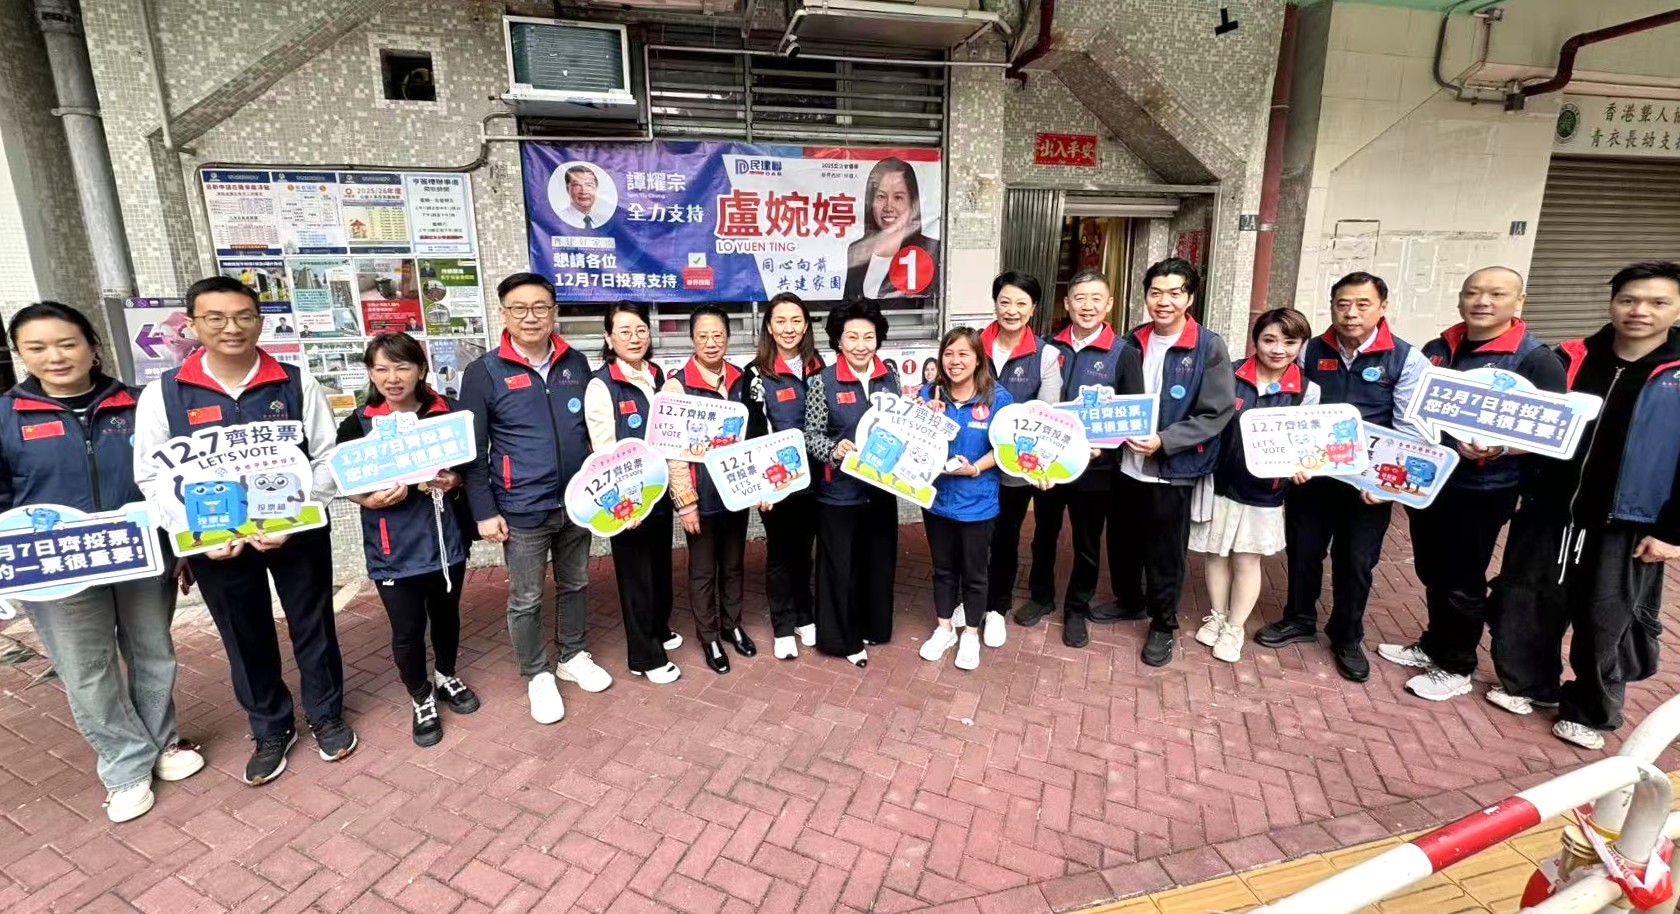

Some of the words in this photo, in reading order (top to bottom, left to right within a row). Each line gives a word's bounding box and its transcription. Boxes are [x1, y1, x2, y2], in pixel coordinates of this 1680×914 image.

[1039, 138, 1094, 160] 出入平安
[750, 160, 782, 172] 民建聯
[626, 172, 686, 192] 譚耀宗
[357, 187, 402, 195] 2025/26年度
[627, 202, 705, 223] 全力支持
[717, 189, 857, 239] 盧婉婷
[1244, 215, 1256, 230] 2A
[718, 241, 732, 252] LO
[736, 241, 765, 252] YUEN
[769, 242, 796, 252] TING
[553, 252, 617, 269] 懇請各位
[762, 257, 828, 272] 同心向前
[899, 249, 918, 290] 1
[555, 272, 678, 289] 12月7日投票支持
[777, 276, 842, 291] 共建家園
[906, 361, 913, 374] 1
[1074, 404, 1146, 419] 7日齊投票，
[661, 430, 682, 438] VOTE
[915, 421, 938, 440] VOTE
[1252, 439, 1275, 449] LET'S
[1262, 446, 1286, 454] VOTE
[198, 452, 238, 470] LET'S
[239, 445, 278, 458] VOTE
[720, 451, 753, 473] 12.7
[726, 465, 758, 484] 齊投票
[731, 476, 752, 494] LET'S
[741, 483, 762, 497] VOTE
